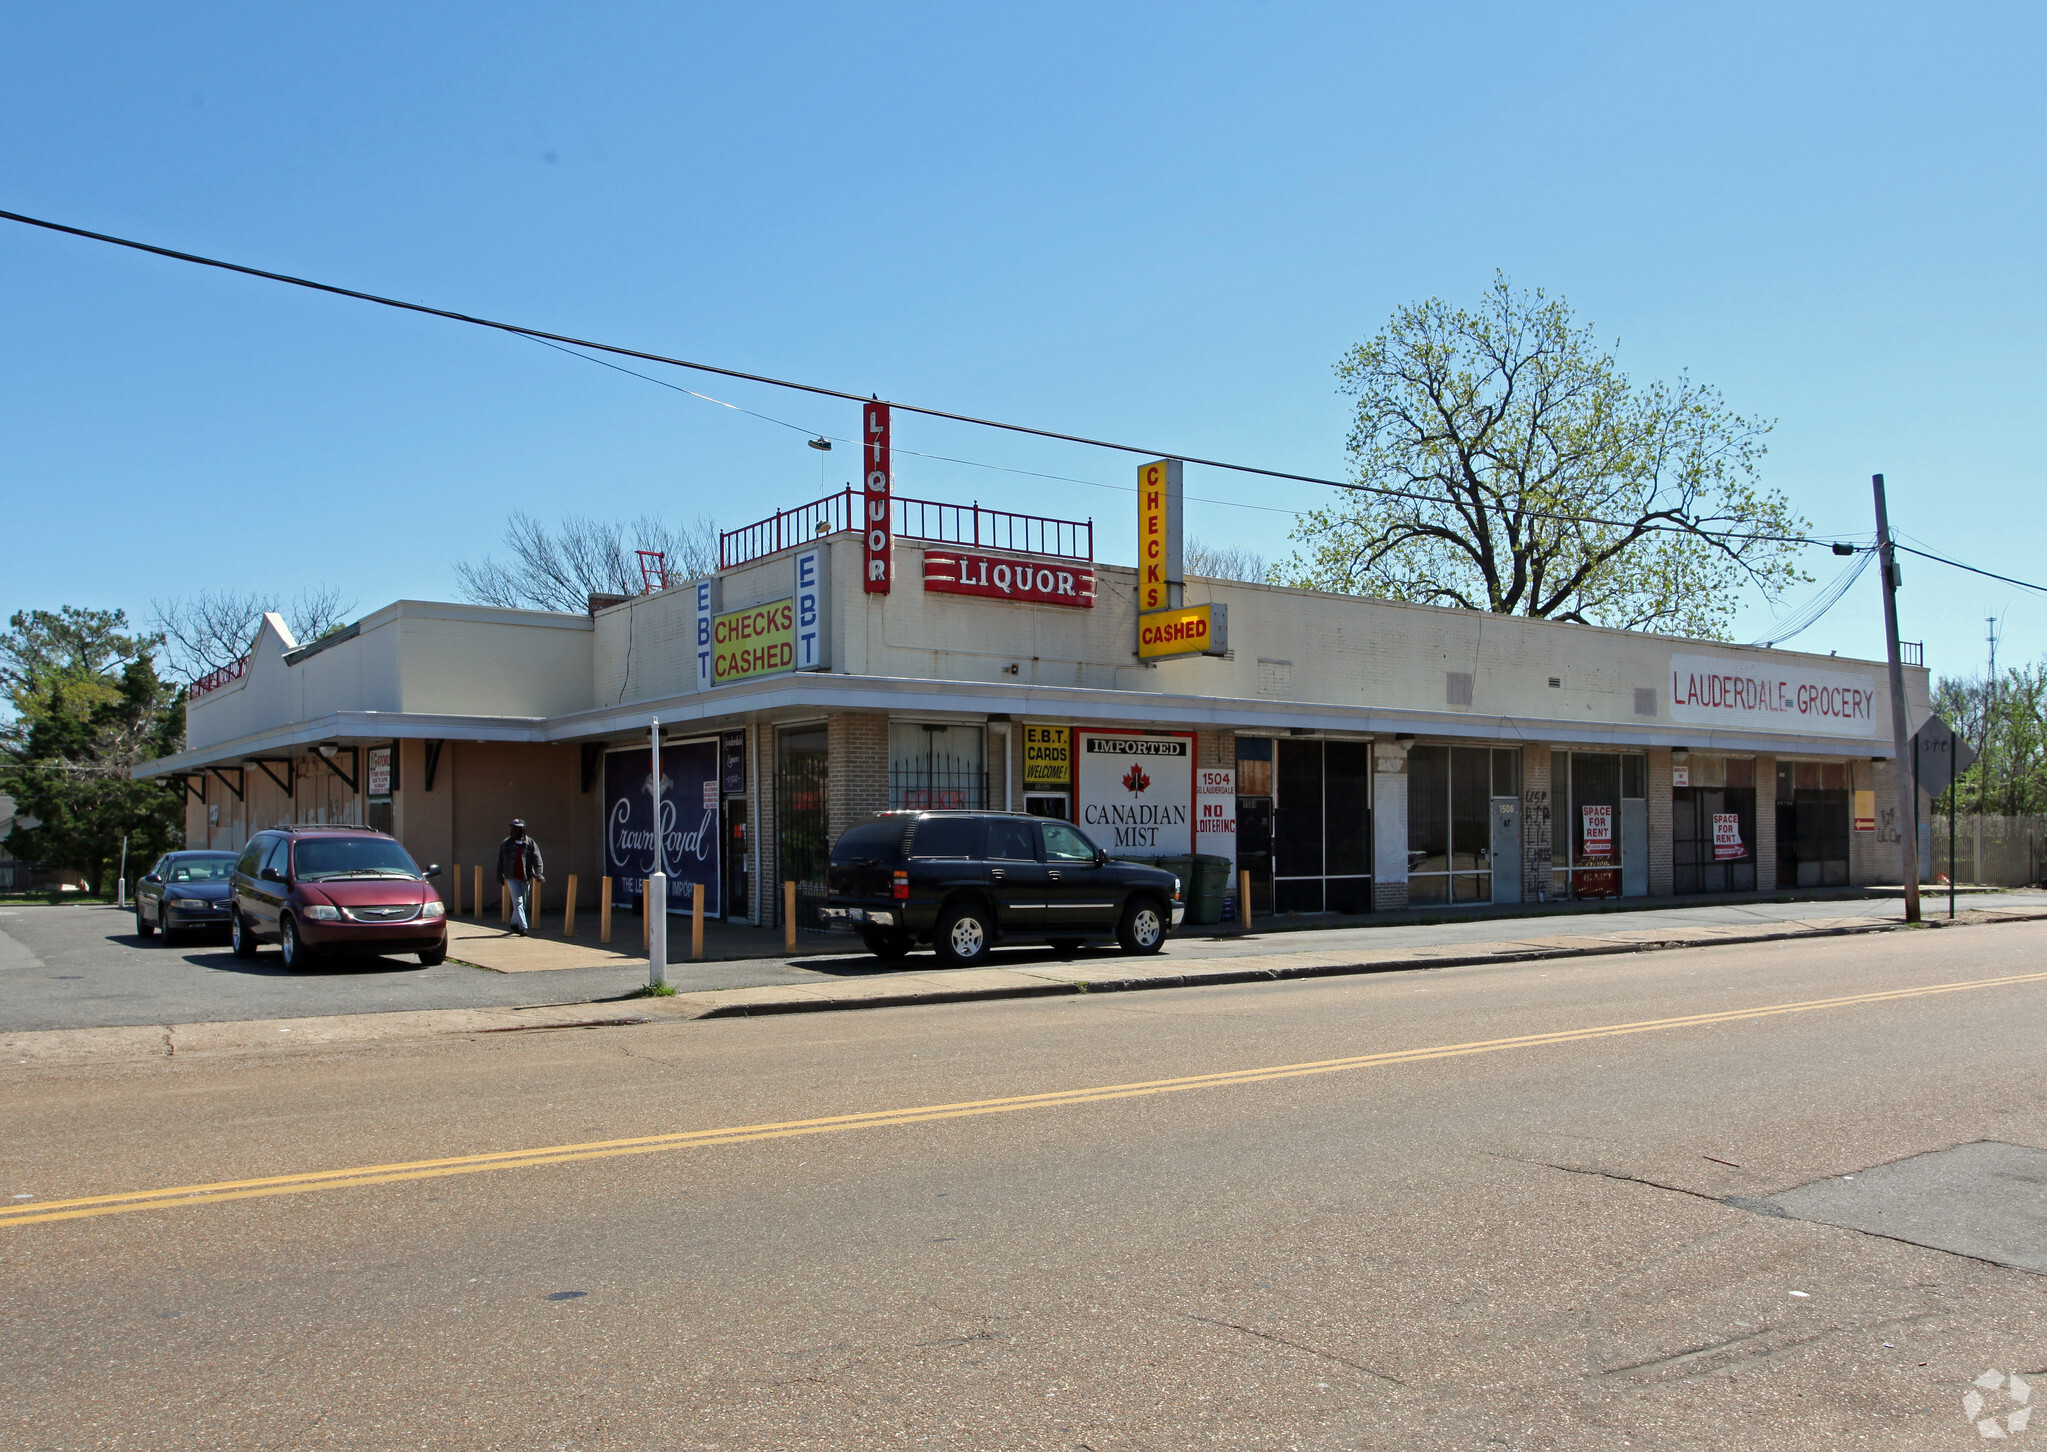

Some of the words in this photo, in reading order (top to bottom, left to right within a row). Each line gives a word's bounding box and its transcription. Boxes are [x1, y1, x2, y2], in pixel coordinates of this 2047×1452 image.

[867, 411, 886, 581] LIQUOR
[1146, 466, 1160, 608] CHECKS
[959, 558, 1076, 596] LIQUOR
[799, 555, 817, 664] EBT
[698, 583, 710, 679] EBT
[715, 605, 793, 644] CHECKS
[1142, 619, 1207, 645] CA$HED
[715, 641, 793, 678] CASHED
[1674, 671, 1788, 712] LAUDERDALE
[1797, 684, 1873, 719] GROCERY
[1027, 729, 1067, 744] E.B.T.
[1027, 746, 1067, 761] CARDS
[1093, 739, 1181, 755] IMPORTED
[1026, 764, 1067, 779] WELCOME!
[1202, 773, 1230, 785] 1504
[1203, 786, 1234, 794] LAUDERDALE
[1085, 804, 1187, 825] CANADIAN
[1203, 804, 1223, 817] NO
[1499, 804, 1515, 813] 1506
[1583, 806, 1611, 816] SPACE
[1589, 817, 1606, 826] FOR
[1713, 815, 1738, 823] SPACE
[1114, 826, 1159, 847] MIST
[1586, 828, 1609, 837] RENT
[1718, 825, 1733, 833] FOR
[1716, 834, 1736, 843] RENT
